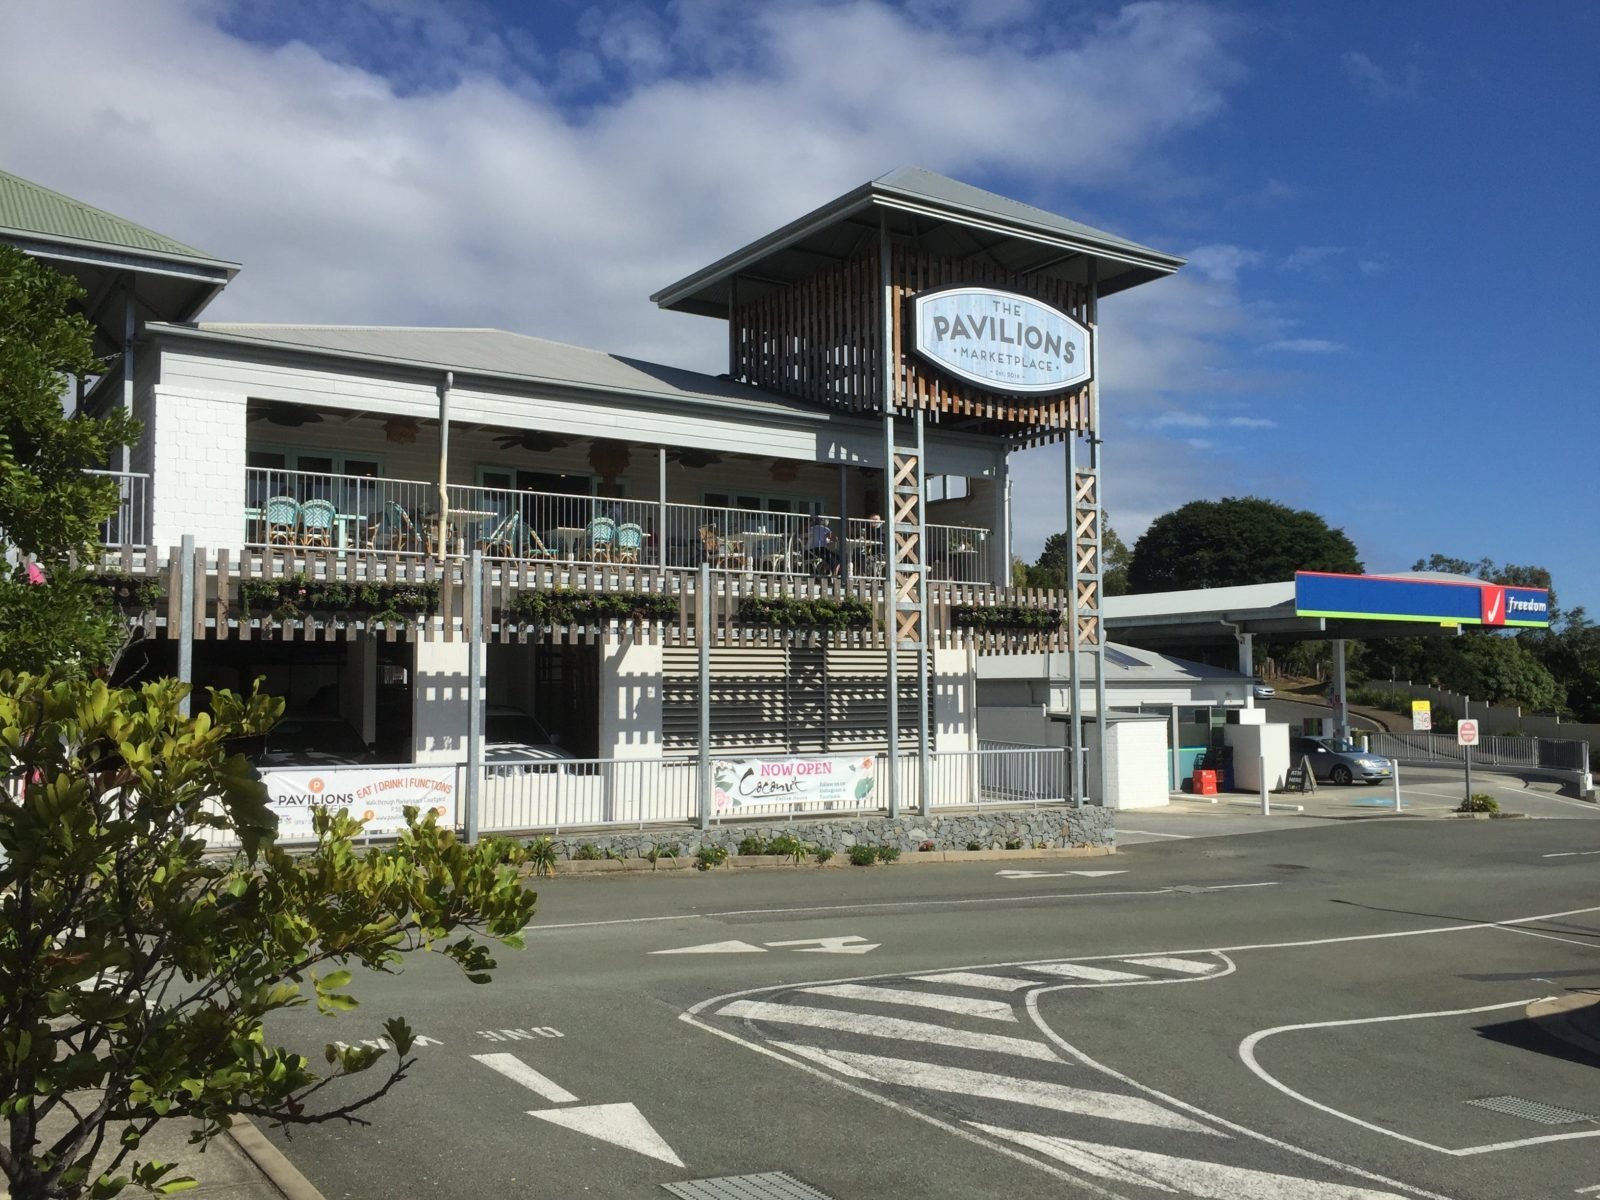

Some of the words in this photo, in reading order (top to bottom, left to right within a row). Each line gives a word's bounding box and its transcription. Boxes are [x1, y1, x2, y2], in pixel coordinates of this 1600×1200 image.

[993, 300, 1021, 316] THE
[933, 313, 1076, 364] PAVILIONS
[960, 347, 1053, 372] MARKETPLACE
[1506, 596, 1547, 613] freedom
[761, 764, 794, 776] NOW
[797, 761, 832, 775] OPEN
[356, 785, 372, 799] EAT
[378, 778, 403, 792] DRINK
[409, 778, 453, 794] FUNCTIONS
[738, 767, 809, 797] Coconut
[278, 793, 354, 805] PAVILIONS
[476, 1026, 565, 1042] ONE
